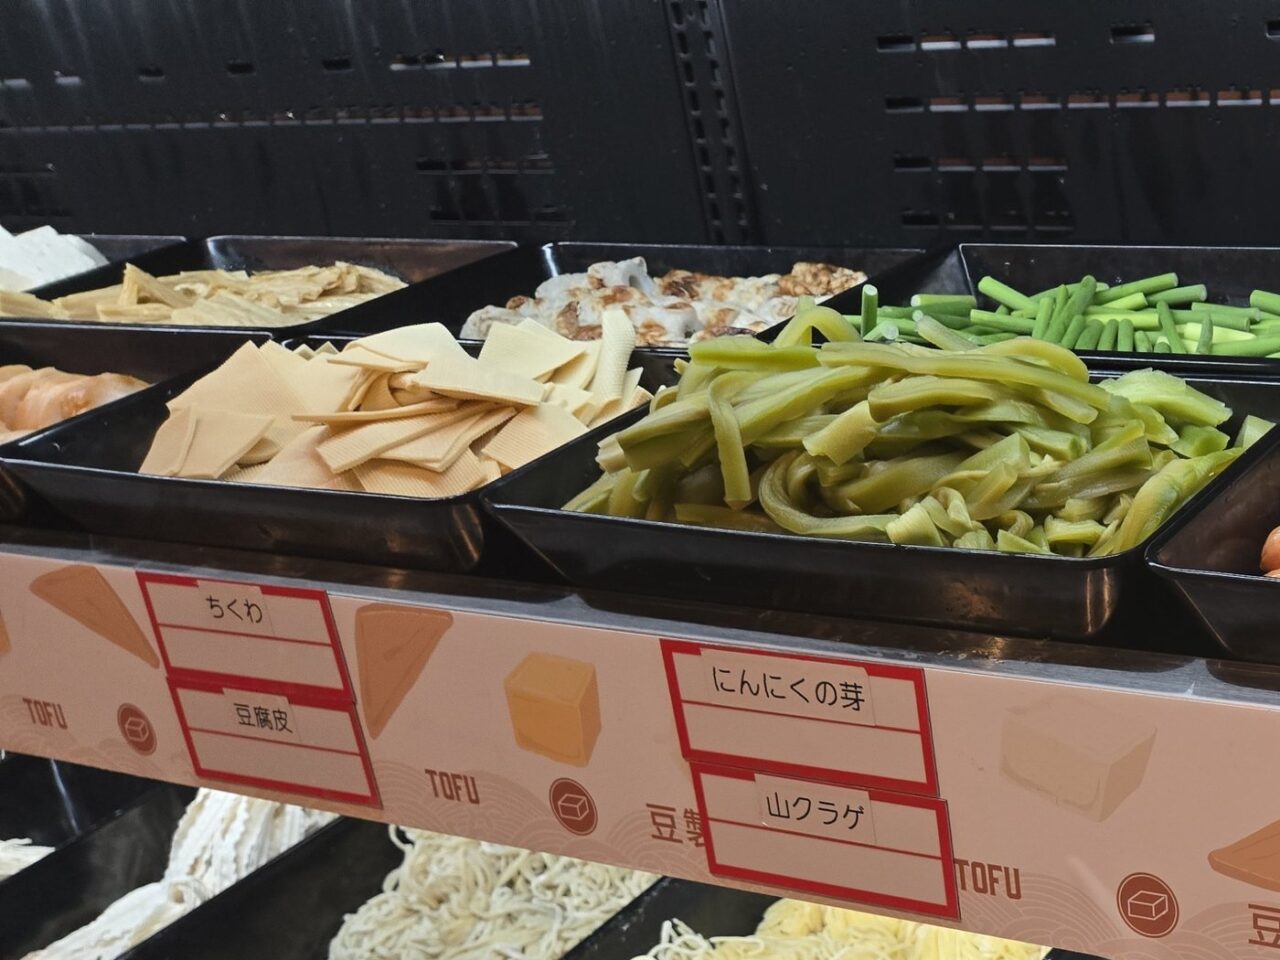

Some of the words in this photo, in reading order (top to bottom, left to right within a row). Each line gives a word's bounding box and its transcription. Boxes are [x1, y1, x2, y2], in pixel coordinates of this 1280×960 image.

[206, 595, 263, 623] ちくわ
[712, 666, 866, 712] にんにくの芽
[22, 697, 68, 730] TOFU
[233, 703, 294, 733] 豆腐皮
[425, 768, 481, 805] TOFU
[766, 791, 865, 830] 山クラゲ
[953, 858, 1022, 900] TOFU
